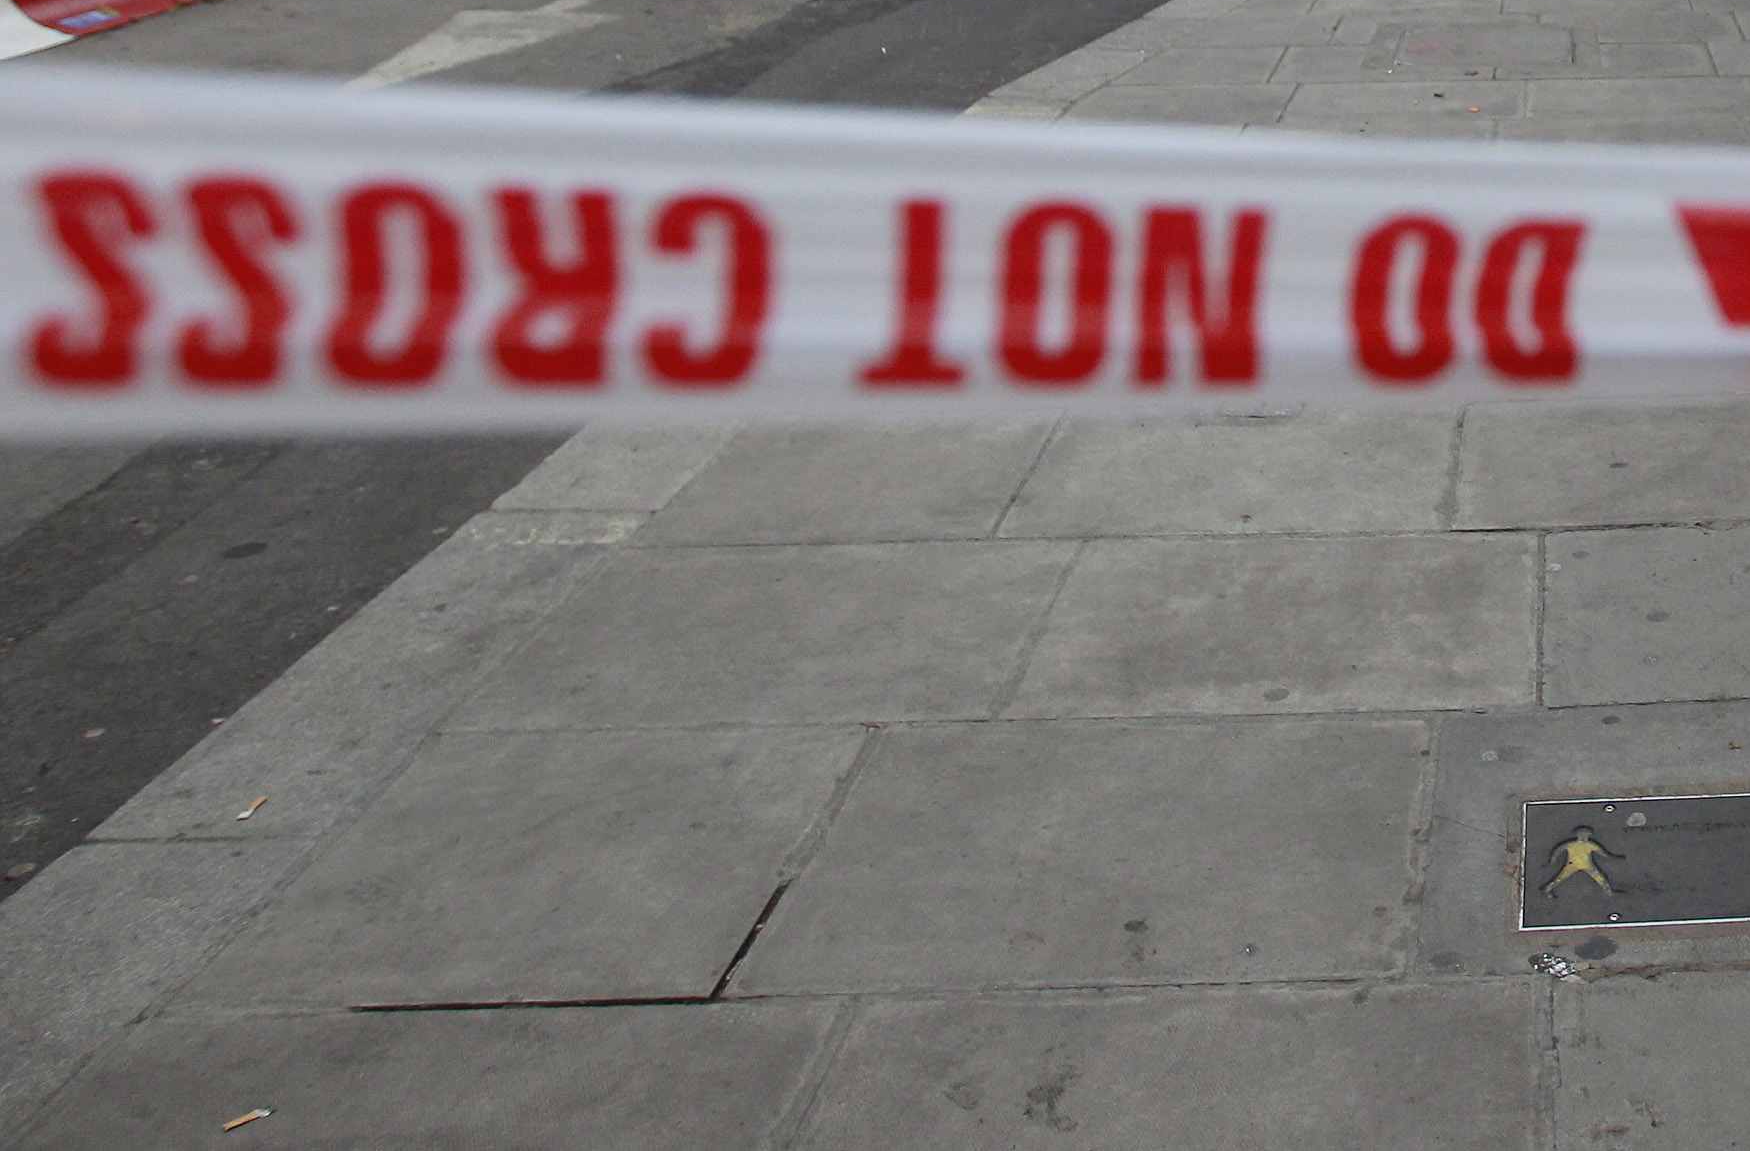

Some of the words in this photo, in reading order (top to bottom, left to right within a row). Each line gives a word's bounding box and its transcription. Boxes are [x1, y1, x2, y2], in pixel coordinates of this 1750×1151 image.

[30, 166, 776, 389] CROSS
[854, 196, 1270, 389] NOT
[1348, 210, 1588, 385] DO
